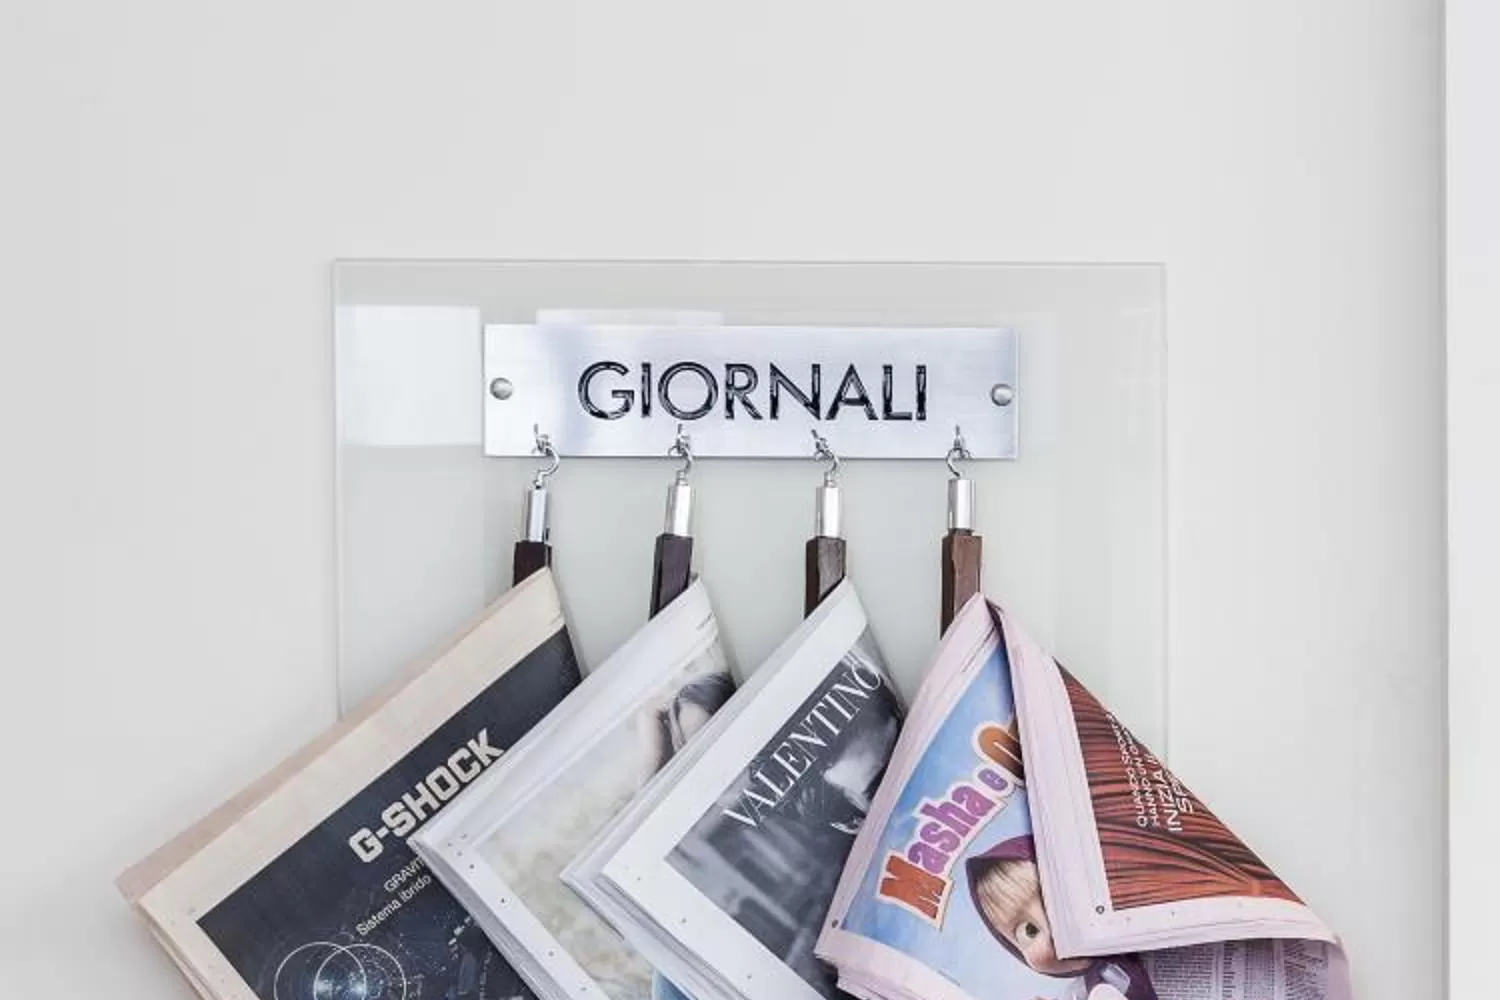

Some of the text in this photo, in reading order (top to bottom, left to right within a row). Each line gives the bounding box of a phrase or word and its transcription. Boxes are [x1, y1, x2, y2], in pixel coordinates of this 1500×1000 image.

[577, 361, 928, 421] GIORNALI
[722, 652, 883, 828] VALENTINO
[348, 727, 505, 863] G-SHOCK
[1153, 769, 1183, 832] INIZIA
[878, 783, 1000, 921] Masha
[355, 874, 432, 937] Sistema ibrido
